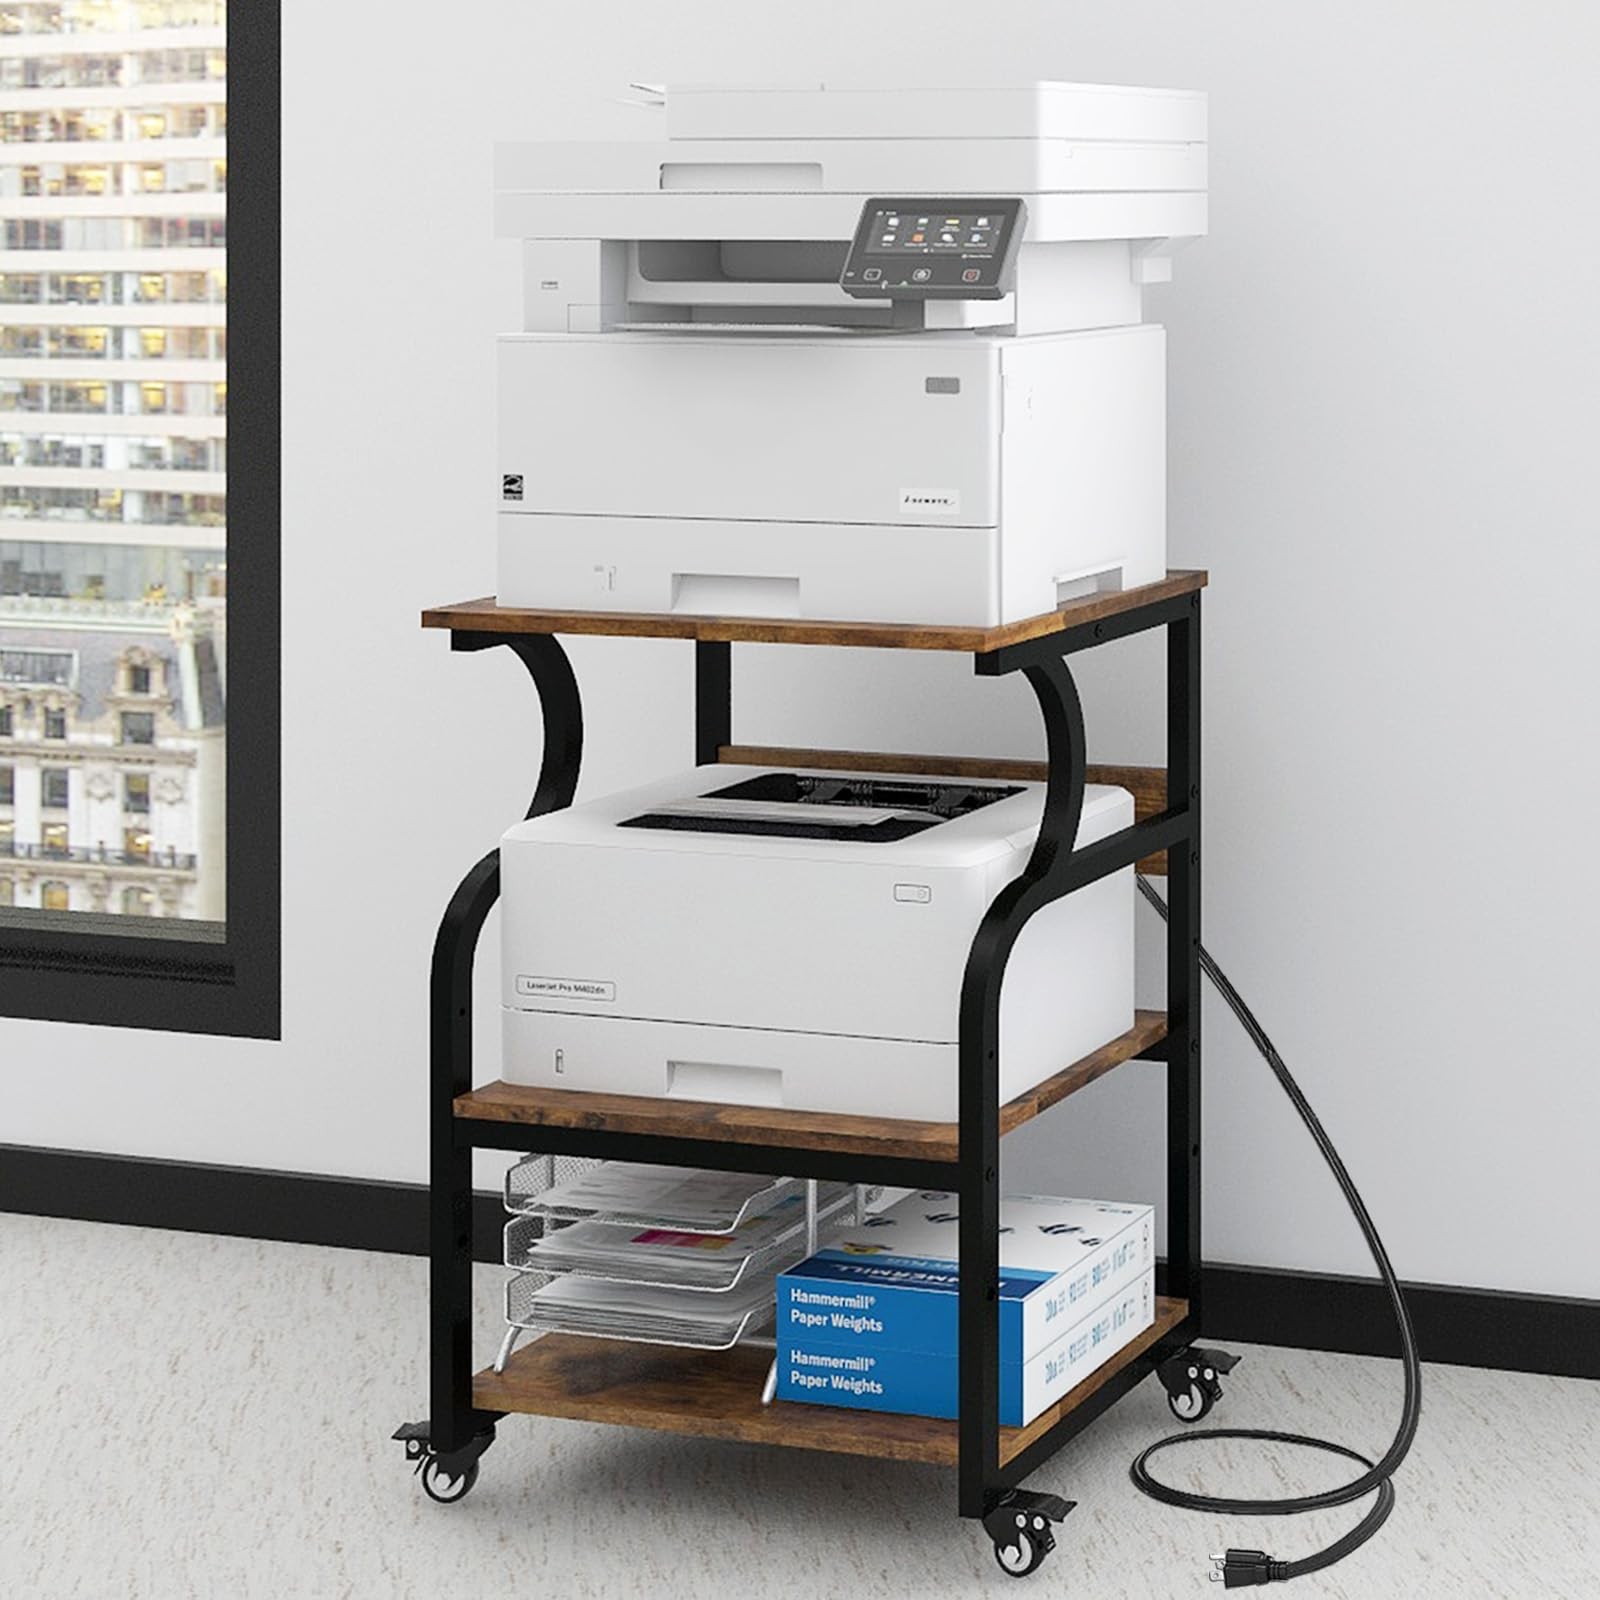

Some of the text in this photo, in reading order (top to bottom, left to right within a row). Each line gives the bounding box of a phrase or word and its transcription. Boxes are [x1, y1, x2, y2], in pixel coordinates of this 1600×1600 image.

[559, 983, 572, 993] Pro
[790, 1308, 883, 1334] Paper Weights
[790, 1370, 883, 1395] Paper Weights
